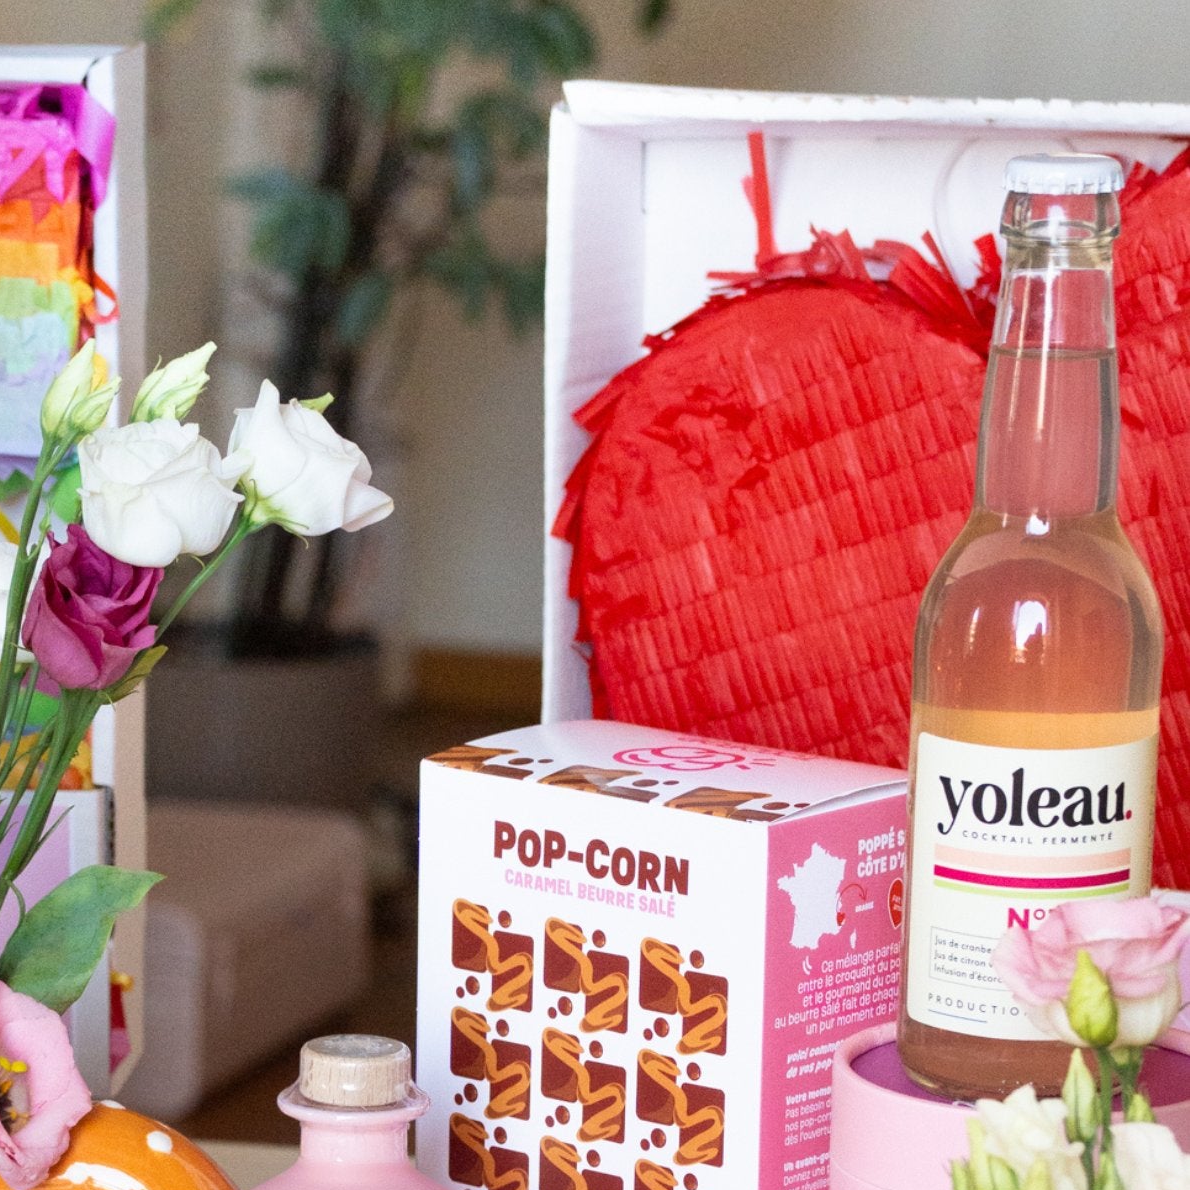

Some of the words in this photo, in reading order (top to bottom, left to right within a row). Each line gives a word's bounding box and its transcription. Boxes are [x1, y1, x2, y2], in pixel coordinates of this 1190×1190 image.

[937, 768, 1133, 836] yoleau.
[857, 826, 895, 855] POPPÉ
[962, 830, 1033, 845] COCKTAIL
[1042, 830, 1113, 845] FERMENTÉ
[493, 820, 690, 896] POP-CORN
[857, 855, 887, 878] CÔTE
[504, 868, 574, 896] CARAMEL
[577, 882, 636, 910] BEURRE
[638, 895, 677, 918] SALÉ
[934, 935, 946, 945] Jus
[948, 939, 958, 948] de
[961, 943, 994, 954] cranbe
[934, 950, 945, 960] Jus
[948, 953, 958, 962] de
[960, 957, 986, 968] citron
[821, 960, 834, 973] Ce
[835, 949, 874, 969] mélange
[934, 963, 967, 977] Infusion
[797, 977, 824, 994] entre
[825, 974, 834, 987] le
[835, 963, 876, 983] croquant
[877, 960, 889, 973] du
[802, 995, 813, 1008] et
[814, 991, 823, 1003] le
[825, 978, 871, 1004] gourmand
[872, 975, 884, 988] du
[774, 1016, 786, 1029] au
[788, 1007, 820, 1026] beurre
[821, 1001, 841, 1017] salé
[842, 996, 857, 1011] fait
[859, 993, 871, 1007] de
[928, 993, 1026, 1016] PRODUCTIO
[806, 1022, 818, 1036] un
[819, 1018, 834, 1036] pur
[836, 1006, 874, 1027] moment
[875, 1003, 887, 1017] de
